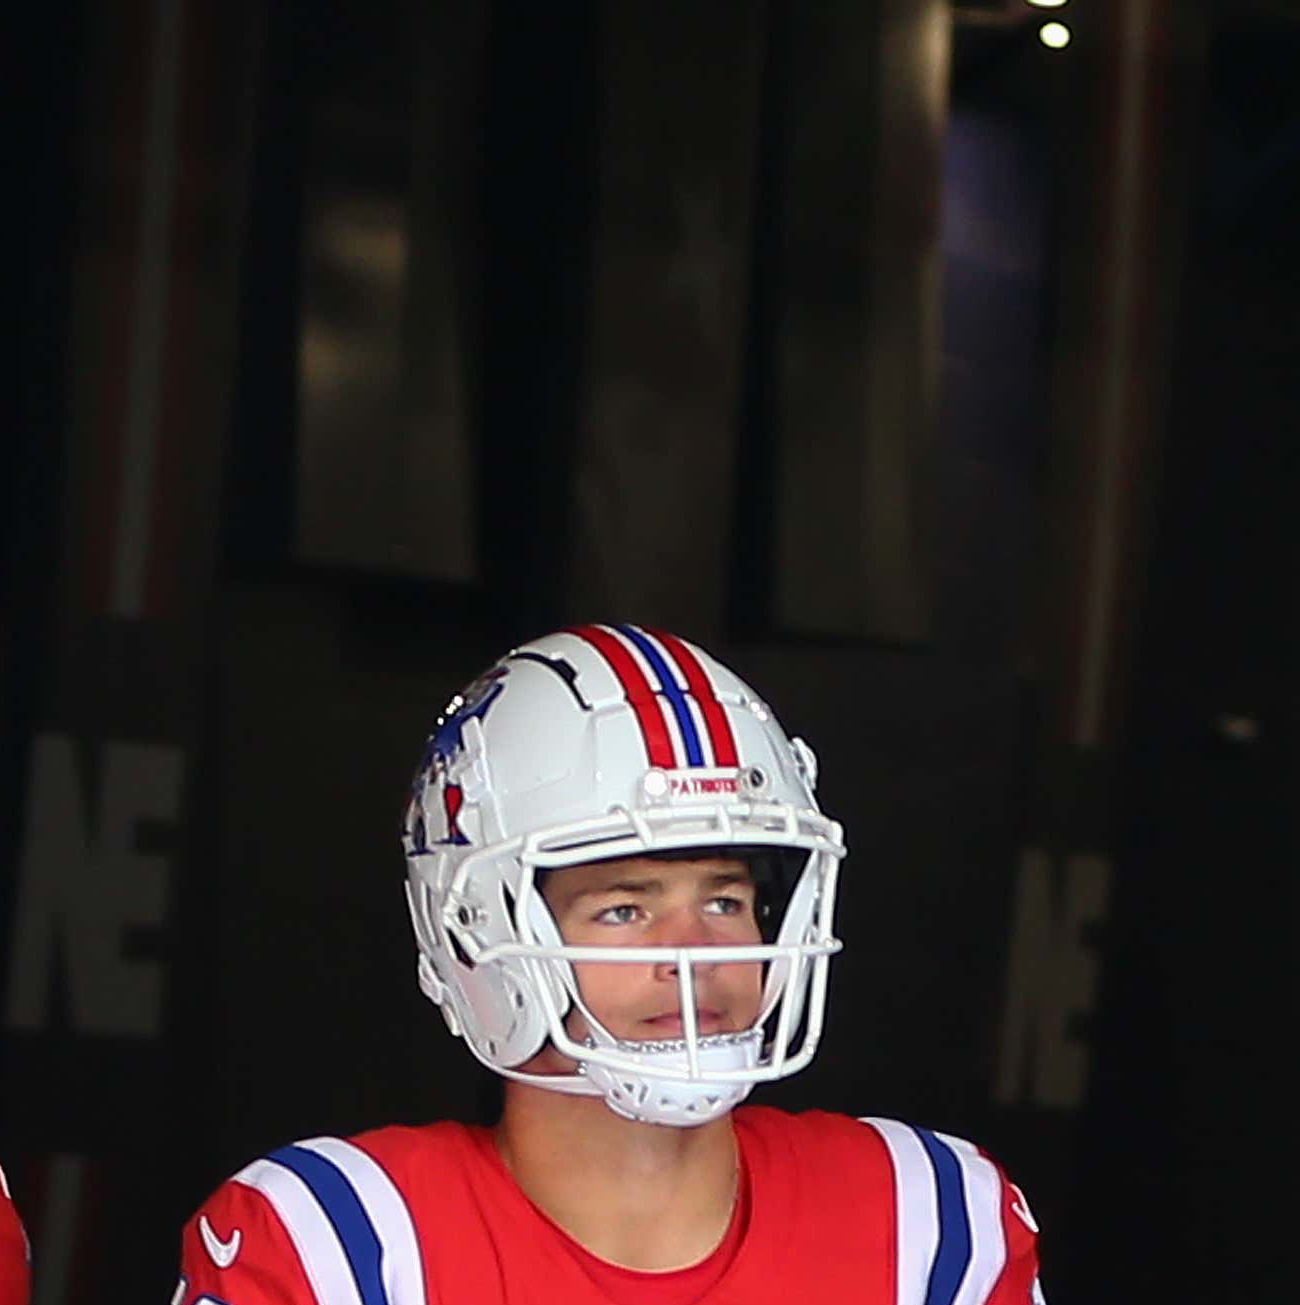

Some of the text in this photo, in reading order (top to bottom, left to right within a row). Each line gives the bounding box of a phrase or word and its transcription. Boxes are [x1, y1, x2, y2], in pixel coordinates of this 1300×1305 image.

[4, 732, 186, 1037] NE
[670, 778, 738, 794] PATRIOTS
[995, 849, 1113, 1108] NE
